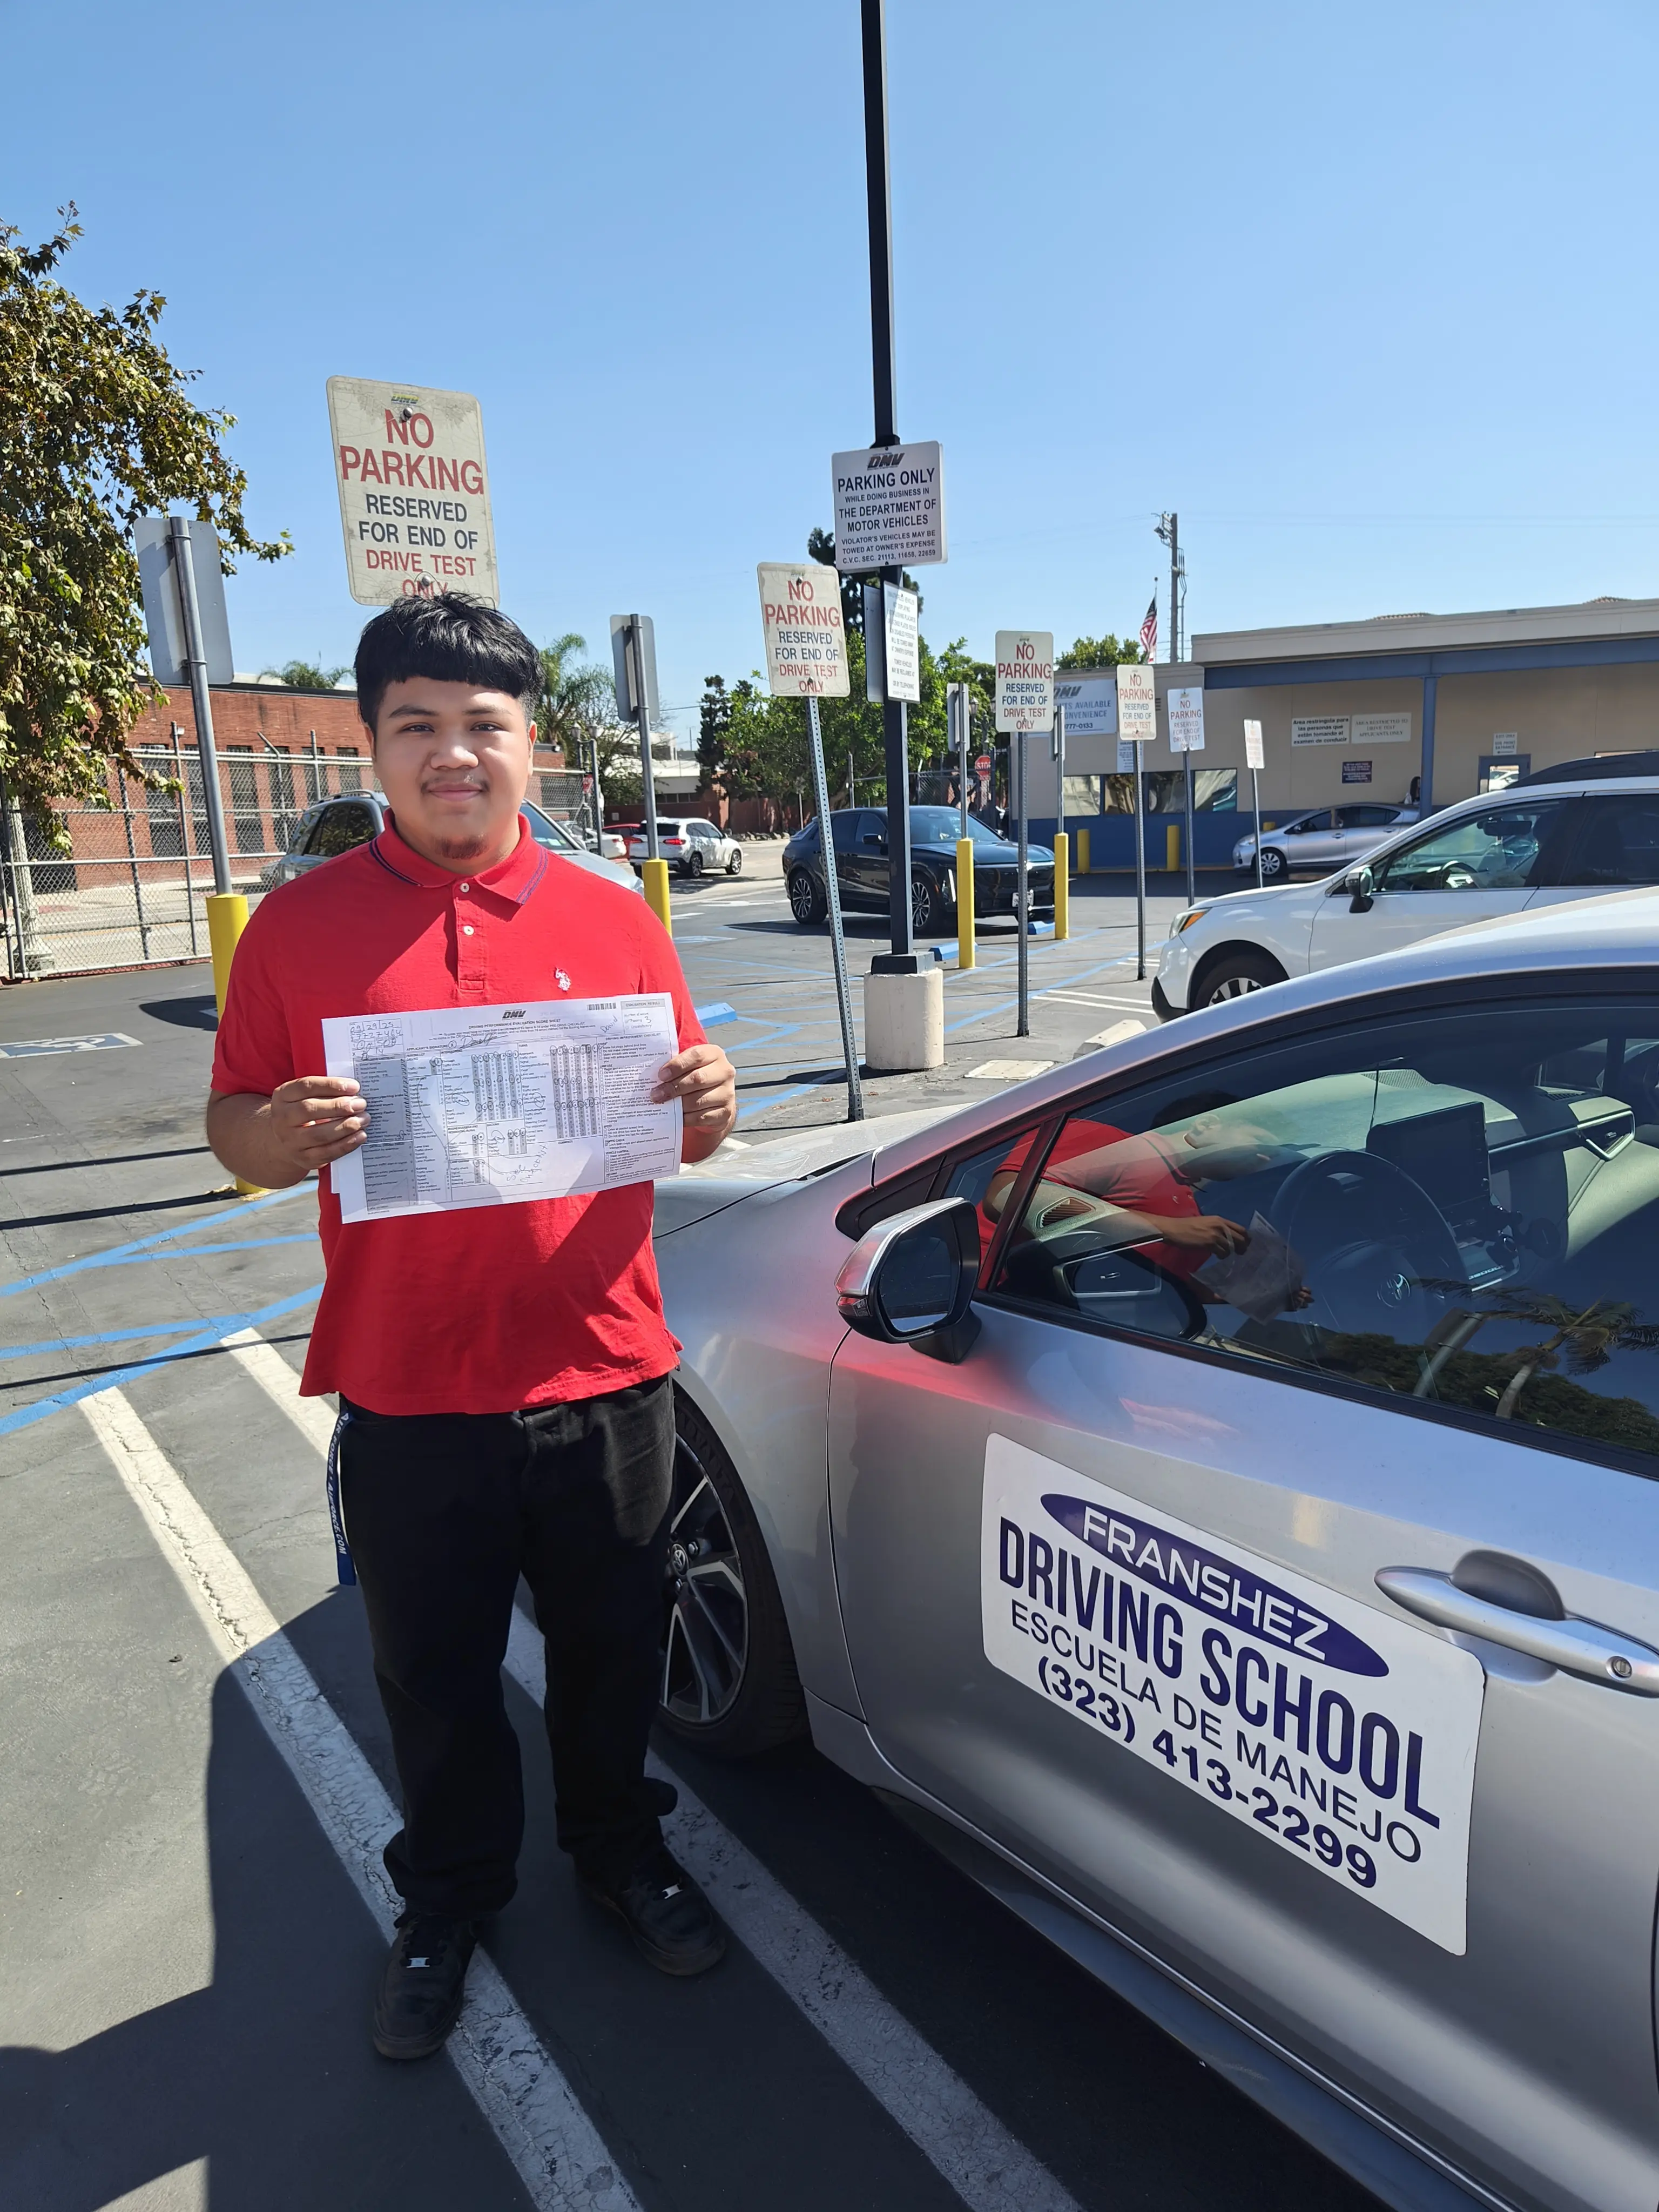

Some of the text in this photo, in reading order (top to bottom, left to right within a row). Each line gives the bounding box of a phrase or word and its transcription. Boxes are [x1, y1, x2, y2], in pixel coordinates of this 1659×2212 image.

[385, 409, 434, 448] NO
[867, 453, 905, 469] DMV
[340, 445, 484, 495] PARKING
[838, 468, 935, 493] PARKING ONLY
[845, 495, 865, 503] WHILE
[867, 492, 887, 501] DOING
[889, 488, 921, 498] BUSINESS
[366, 494, 467, 522] RESERVED
[839, 499, 936, 518] THE DEPARTMENT OF
[847, 515, 928, 532] MOTOR VEHICLES
[359, 521, 478, 549] FOR END OF
[841, 535, 878, 545] VIOLATOR'S
[879, 532, 910, 542] VEHICLES
[875, 542, 905, 551] OWNER'S
[906, 540, 935, 548] EXPENSE
[366, 549, 476, 576] DRIVE TEST
[788, 581, 814, 602] NO
[765, 604, 840, 628] PARKING
[779, 631, 832, 644] RESERVED
[775, 648, 838, 661] FOR END OF
[1016, 644, 1034, 660] NO
[779, 665, 838, 677] DRIVE TEST
[998, 663, 1052, 679] PARKING
[799, 680, 824, 693] ONLY
[1006, 684, 1044, 692] RESERVED
[1130, 675, 1142, 686] NO
[1002, 696, 1048, 705] FOR END OF
[1120, 689, 1154, 700] PARKING
[1075, 700, 1111, 709] AVAILABLE
[1180, 700, 1190, 709] NO
[1004, 709, 1046, 717] DRIVE TEST
[1065, 710, 1107, 719] ONVENIENCE
[1170, 710, 1202, 720] PARKING
[1016, 720, 1034, 730] ONLY
[502, 1010, 527, 1019] DMV
[335, 1413, 349, 1434] AIR
[328, 1435, 338, 1474] FORCE
[1083, 1506, 1329, 1661] FRANSHEZ
[1000, 1516, 1440, 1830] DRIVING SCHOOL
[1011, 1599, 1422, 1863] ESCUELA DE MANEJO
[1037, 1655, 1377, 1889] (323) 413-2299
